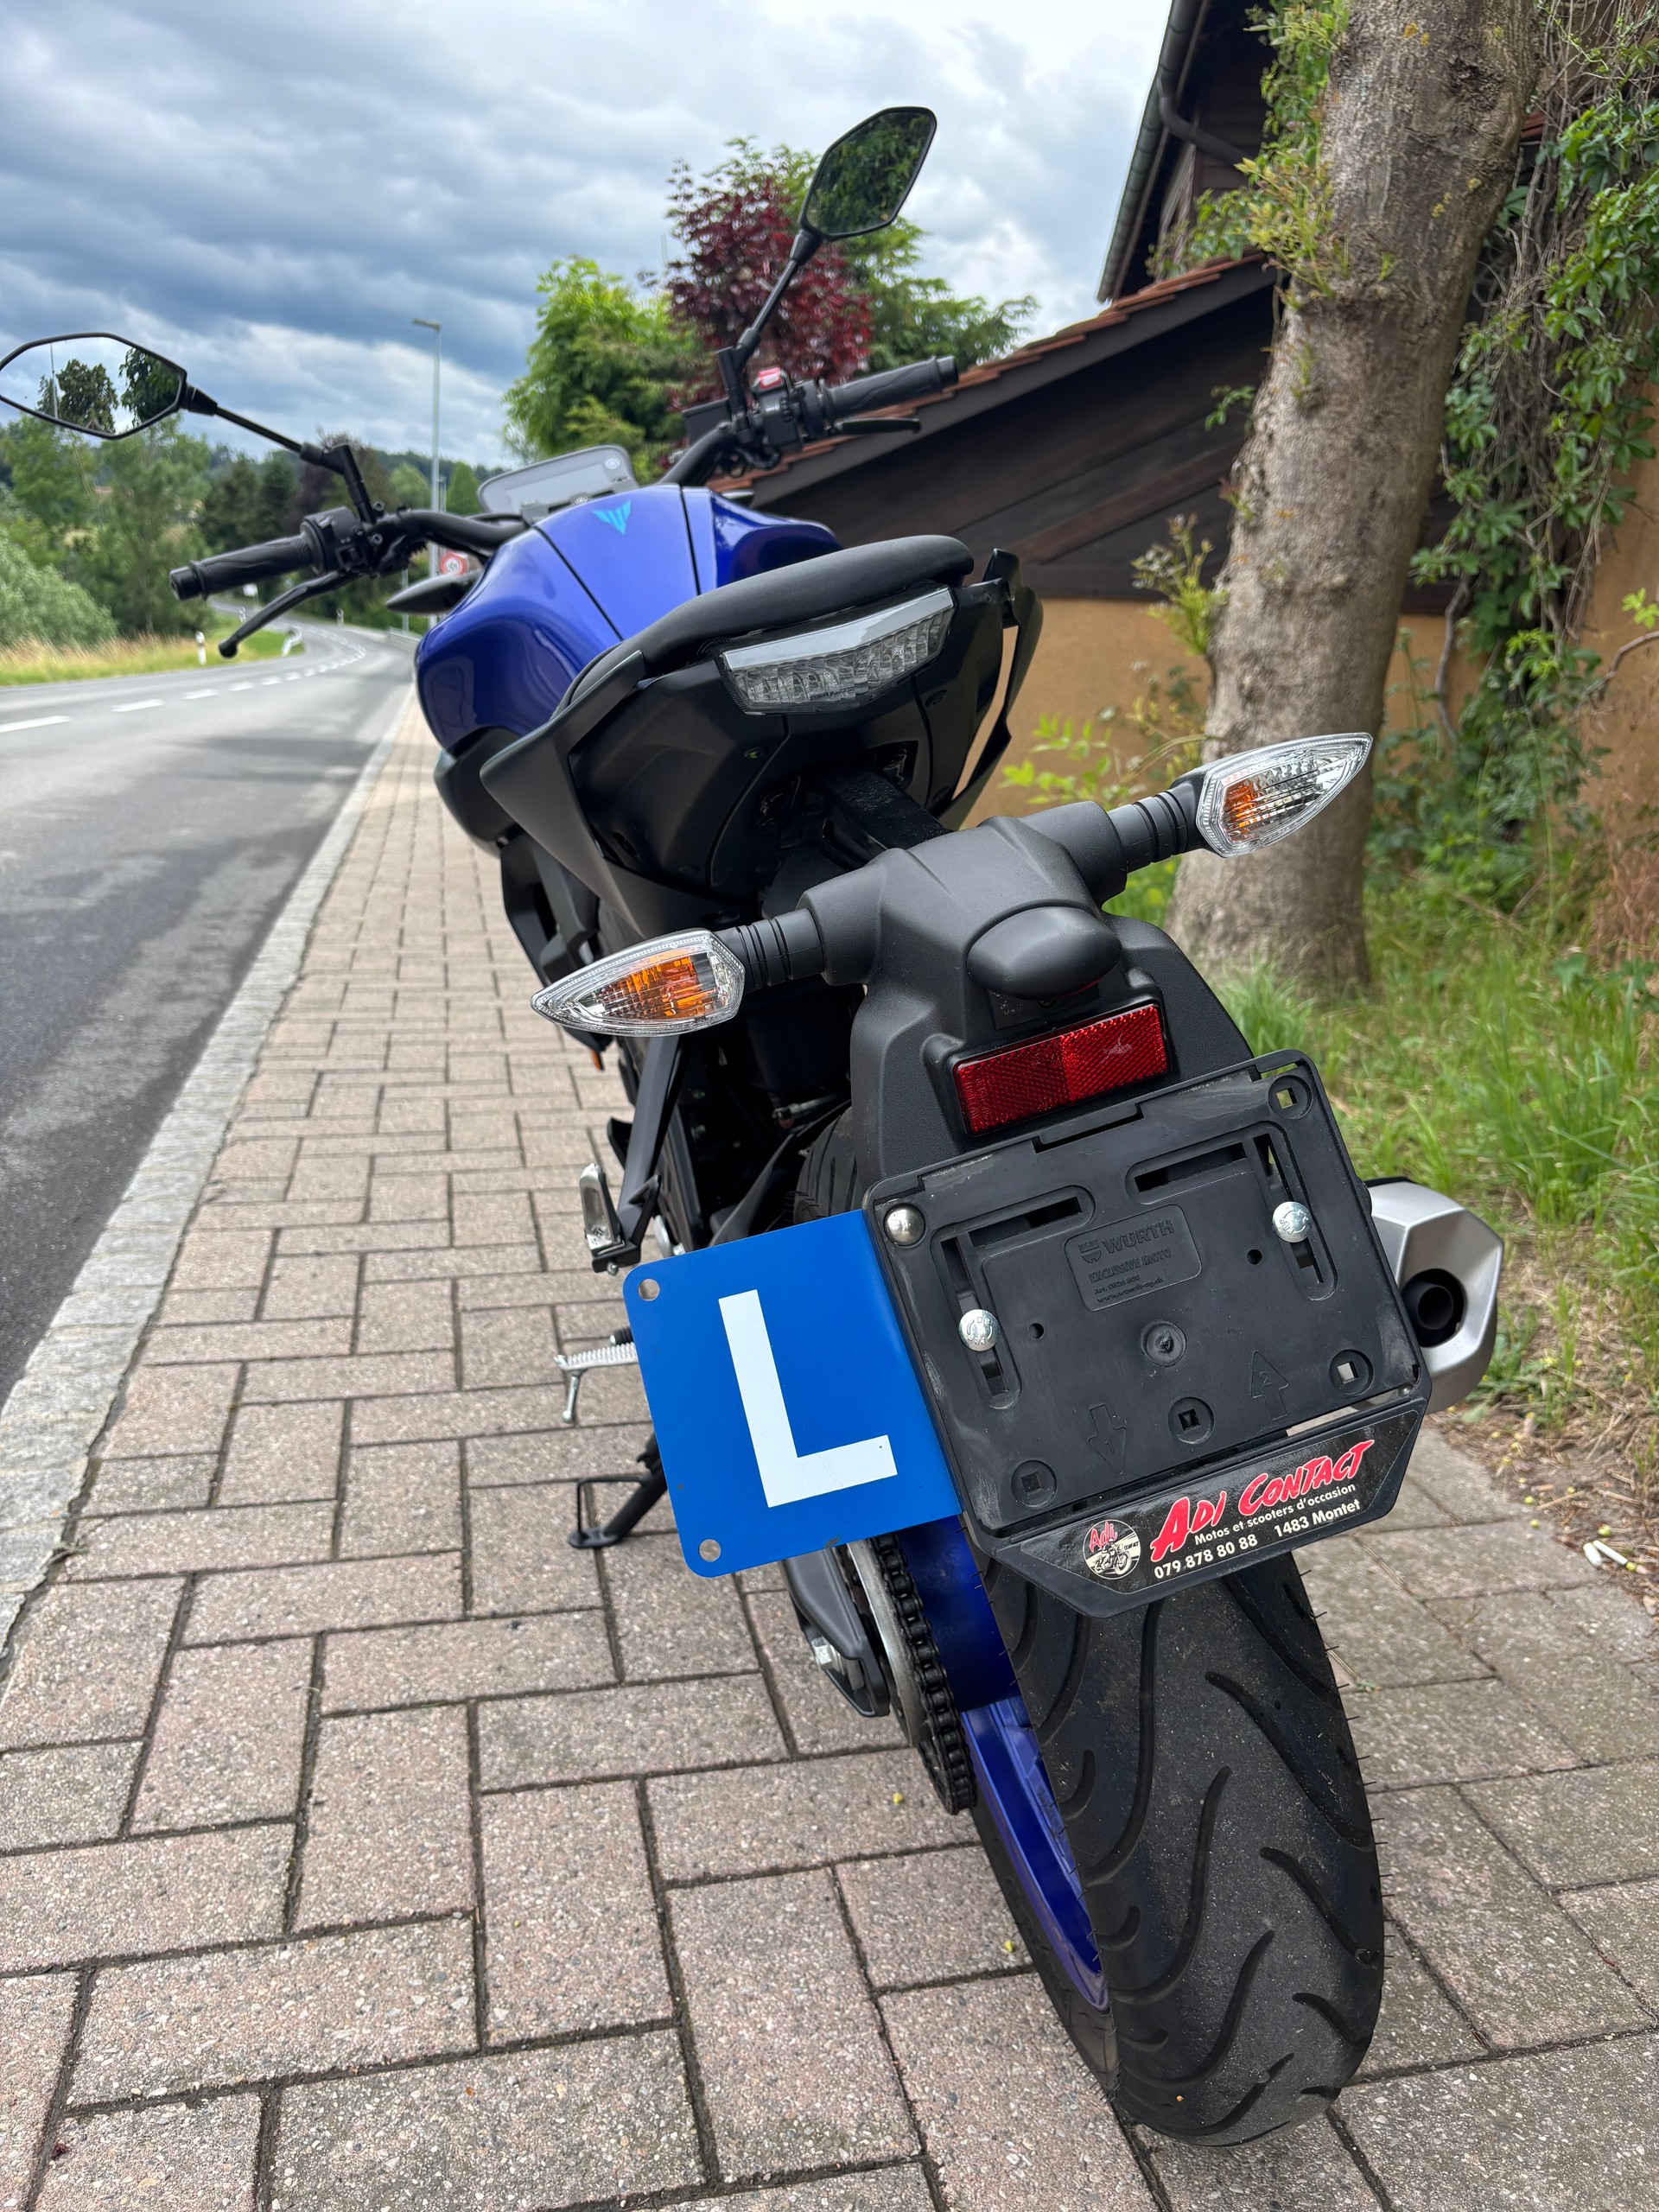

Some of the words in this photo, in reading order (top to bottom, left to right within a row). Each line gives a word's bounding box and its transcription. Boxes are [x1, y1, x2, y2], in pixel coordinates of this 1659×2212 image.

[1089, 1257, 1141, 1283] EXCLUSIVE
[1141, 1247, 1172, 1266] MOTO
[1102, 1219, 1175, 1254] WÜRTH
[718, 1289, 898, 1508] L
[1150, 1491, 1227, 1562] ADI
[1238, 1440, 1375, 1516] CONTACT
[1194, 1527, 1230, 1545] Motos
[1232, 1521, 1244, 1532] et
[1247, 1504, 1294, 1528] scooters
[1296, 1484, 1356, 1510] d'occasion
[1089, 1521, 1118, 1554] Adi
[1154, 1560, 1181, 1579] 079
[1185, 1549, 1214, 1568] 878
[1216, 1541, 1236, 1557] 80
[1238, 1534, 1258, 1550] 88
[1274, 1516, 1310, 1537] 1483
[1312, 1499, 1361, 1525] Montet
